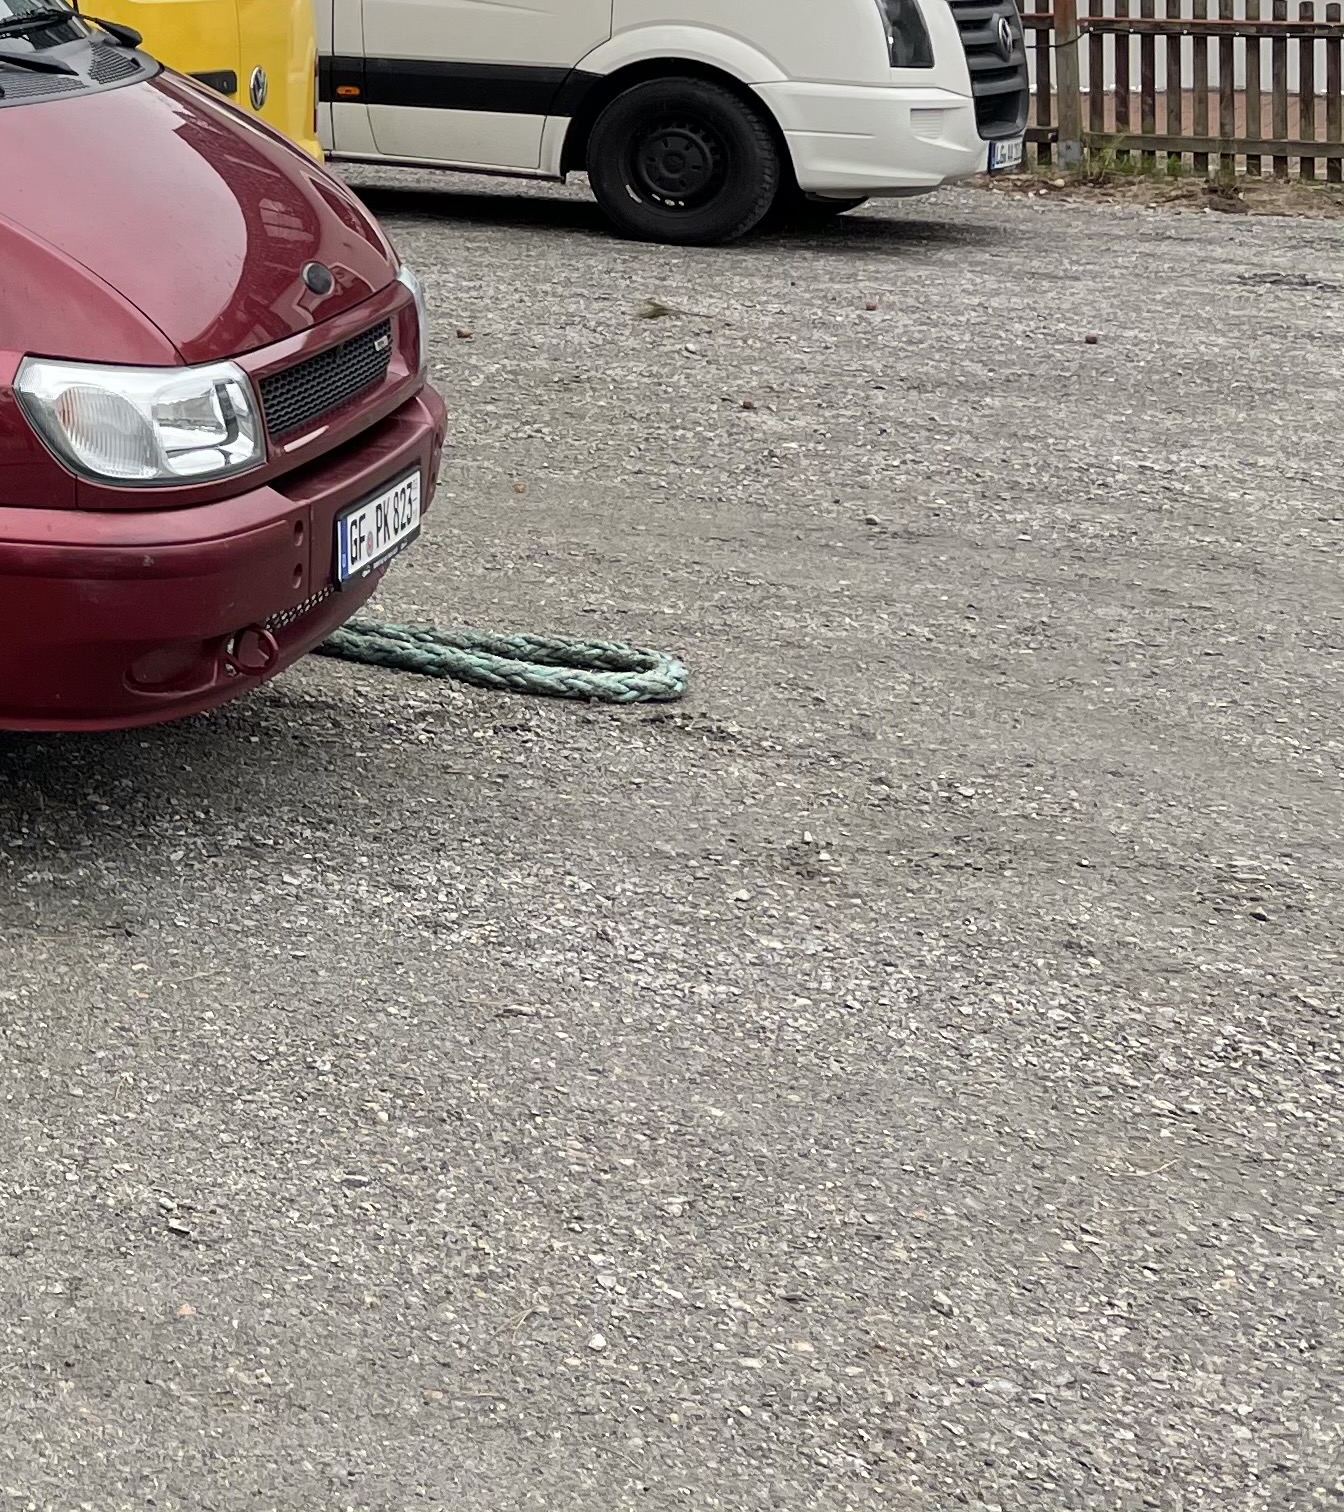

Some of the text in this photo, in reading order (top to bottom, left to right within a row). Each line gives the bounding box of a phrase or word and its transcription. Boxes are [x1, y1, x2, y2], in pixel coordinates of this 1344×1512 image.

[350, 513, 366, 565] GF
[376, 497, 391, 548] PK
[393, 481, 413, 536] 823
